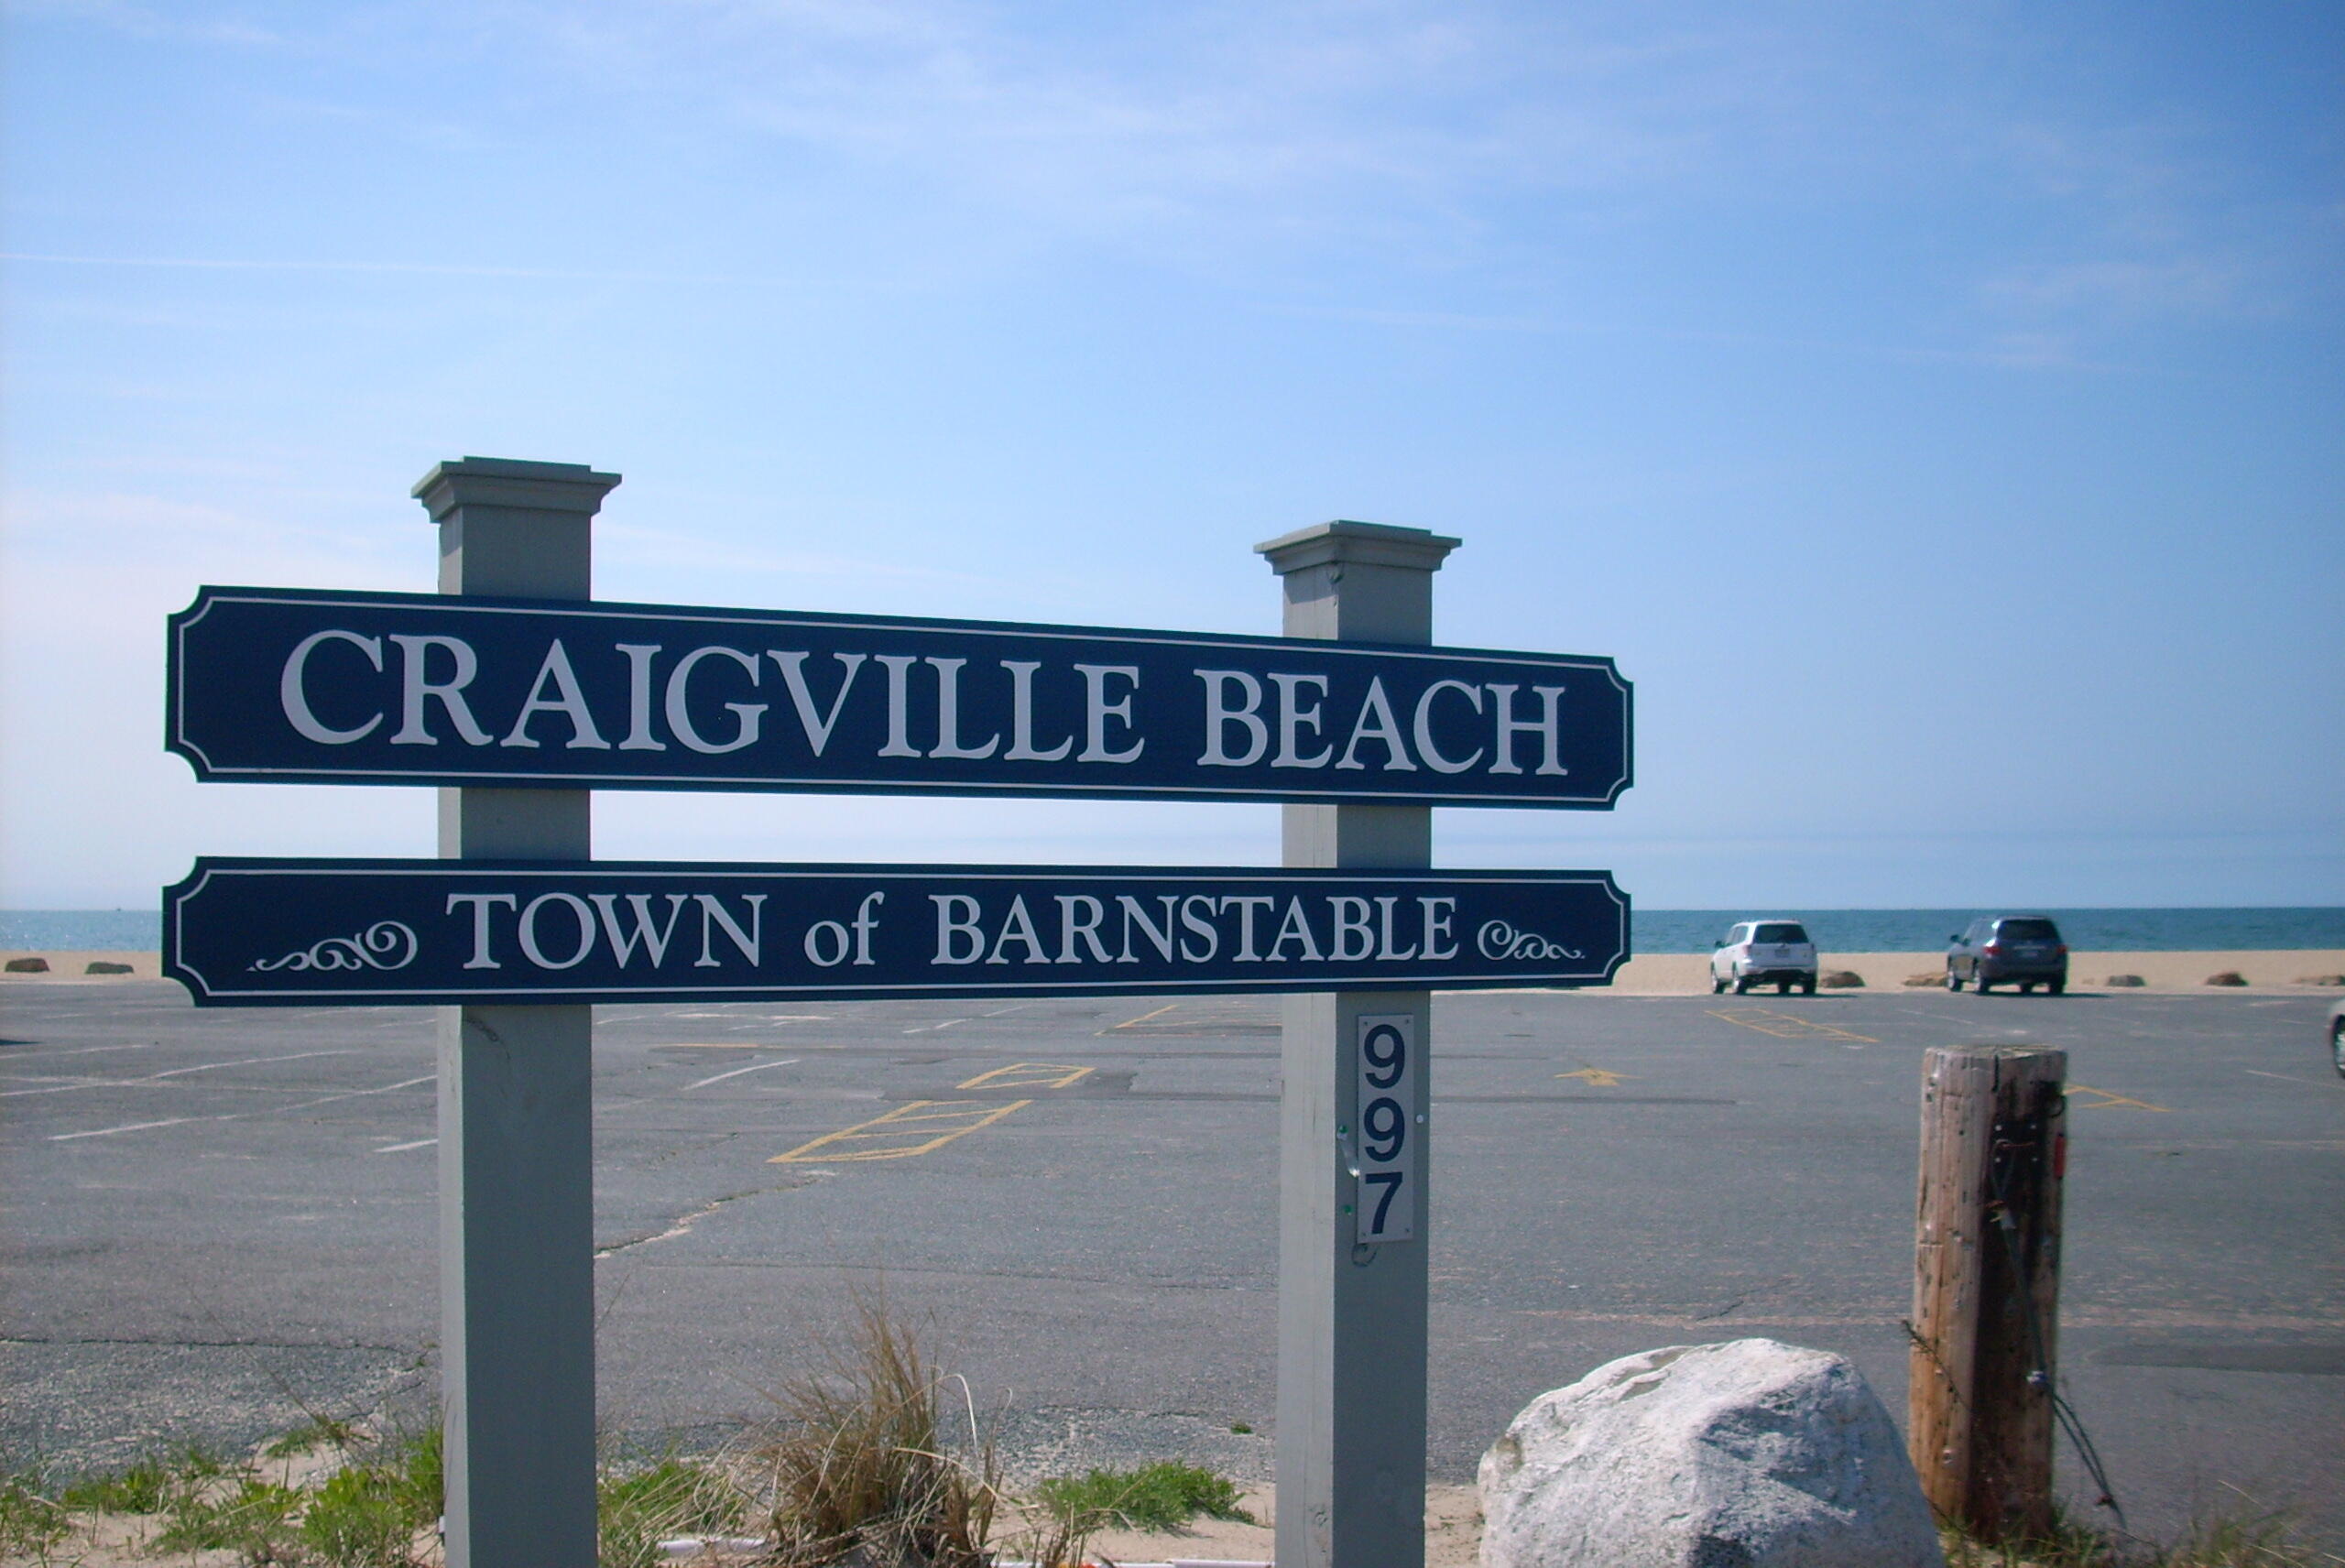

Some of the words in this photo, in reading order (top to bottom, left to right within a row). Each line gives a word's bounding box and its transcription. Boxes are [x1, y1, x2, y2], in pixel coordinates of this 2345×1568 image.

[280, 629, 1145, 765] CRAIGVILLE
[1193, 668, 1568, 776] BEACH
[445, 892, 769, 971] TOWN
[802, 891, 885, 967] of
[928, 893, 1460, 966] BARNSTABLE
[1364, 1024, 1405, 1235] 997
